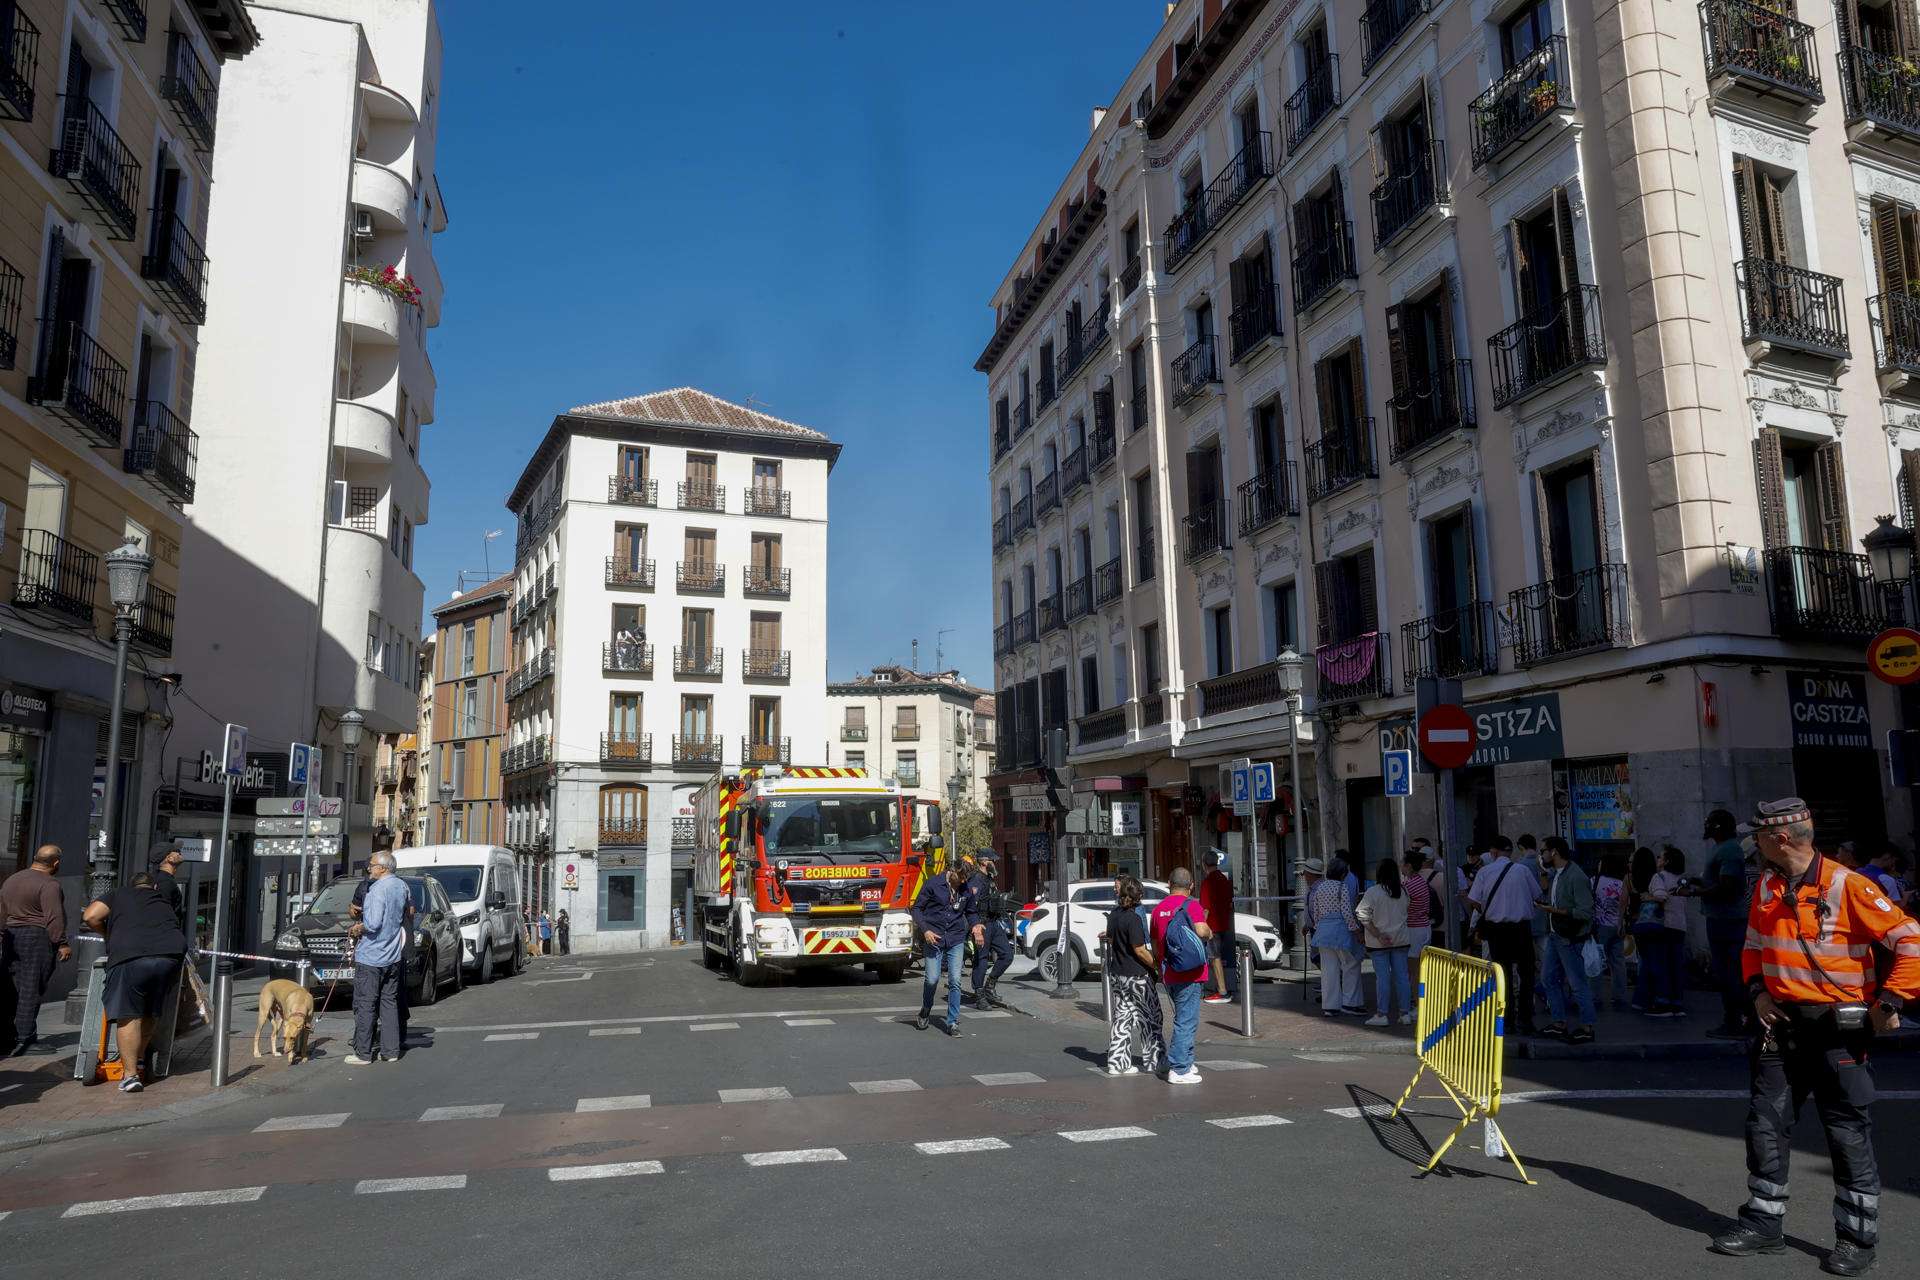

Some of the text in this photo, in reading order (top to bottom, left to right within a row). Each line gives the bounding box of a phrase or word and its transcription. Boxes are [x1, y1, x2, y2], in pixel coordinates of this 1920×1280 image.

[1475, 704, 1557, 741] STIZA
[1792, 702, 1869, 724] CASTIZA
[1255, 769, 1267, 799] P
[1388, 757, 1403, 791] P
[861, 890, 881, 899] PB-21
